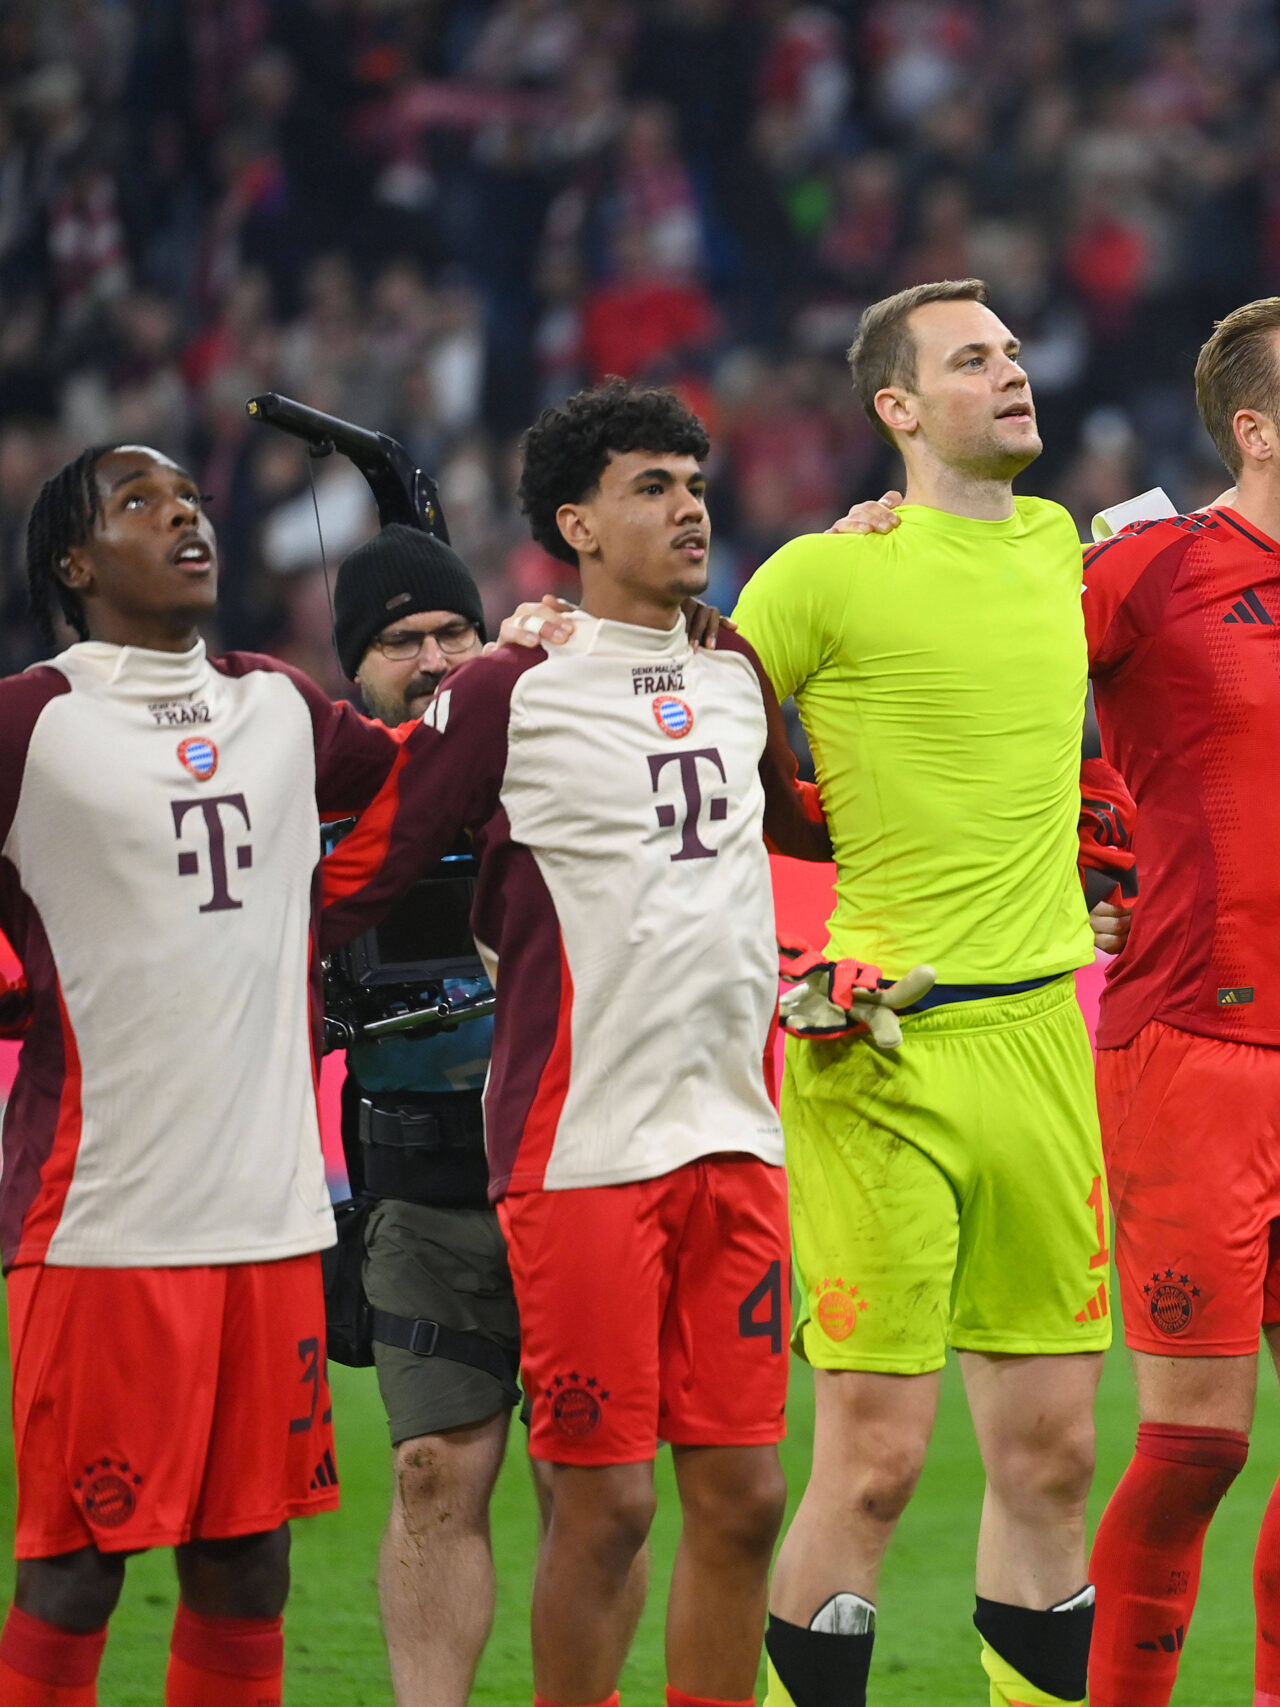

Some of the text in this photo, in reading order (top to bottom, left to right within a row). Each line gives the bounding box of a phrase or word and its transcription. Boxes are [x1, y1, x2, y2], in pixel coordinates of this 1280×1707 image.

[633, 673, 686, 695] FRANZ
[170, 793, 253, 913] T
[646, 747, 728, 862] T
[1086, 1175, 1109, 1270] 1
